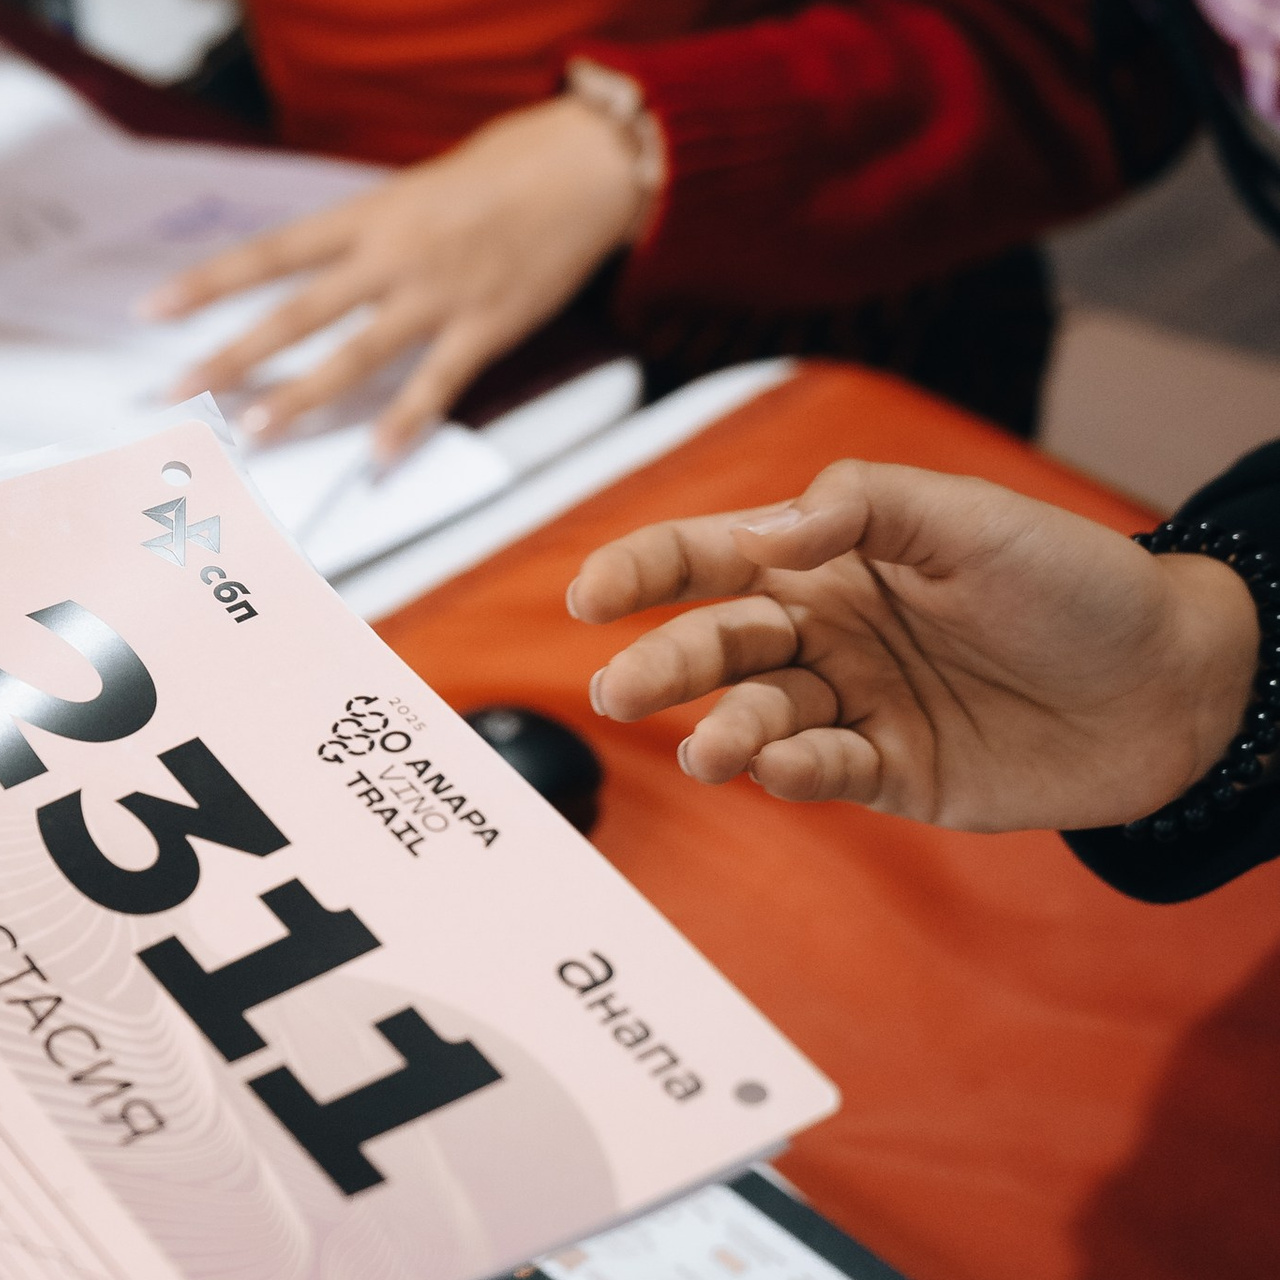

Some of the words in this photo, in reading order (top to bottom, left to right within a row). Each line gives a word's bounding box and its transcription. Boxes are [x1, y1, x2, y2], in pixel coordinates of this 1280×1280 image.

[200, 566, 259, 623] сбп
[388, 696, 428, 733] 2025
[347, 770, 425, 858] TRAIL
[379, 764, 450, 833] VINO
[405, 759, 500, 848] ANAPA
